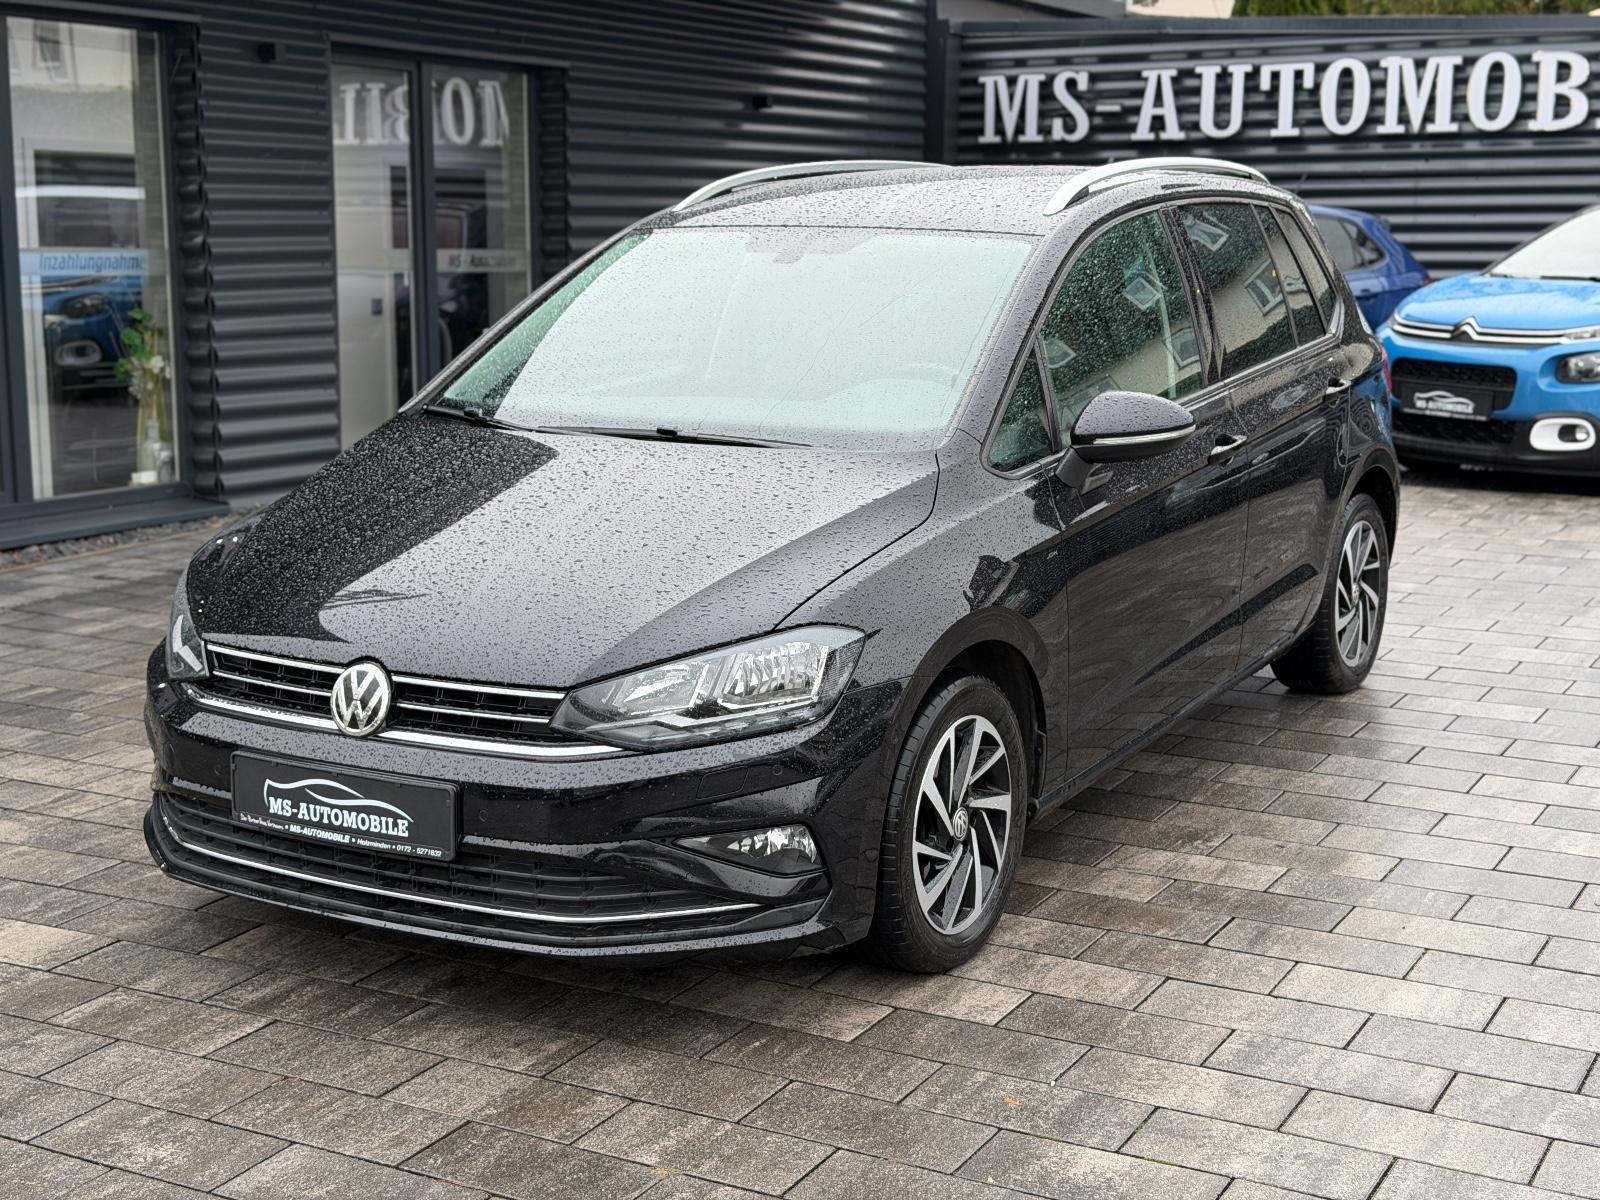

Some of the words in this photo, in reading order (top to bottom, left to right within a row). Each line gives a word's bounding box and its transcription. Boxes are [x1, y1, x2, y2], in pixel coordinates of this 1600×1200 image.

[978, 51, 1600, 144] MS-AUTOMOB
[331, 661, 391, 736] VW
[268, 796, 409, 838] MS-AUTOMOBILE
[289, 823, 351, 844] MS-AUTOMOBILE
[356, 838, 391, 850] Holzminden
[396, 844, 412, 853] 0172
